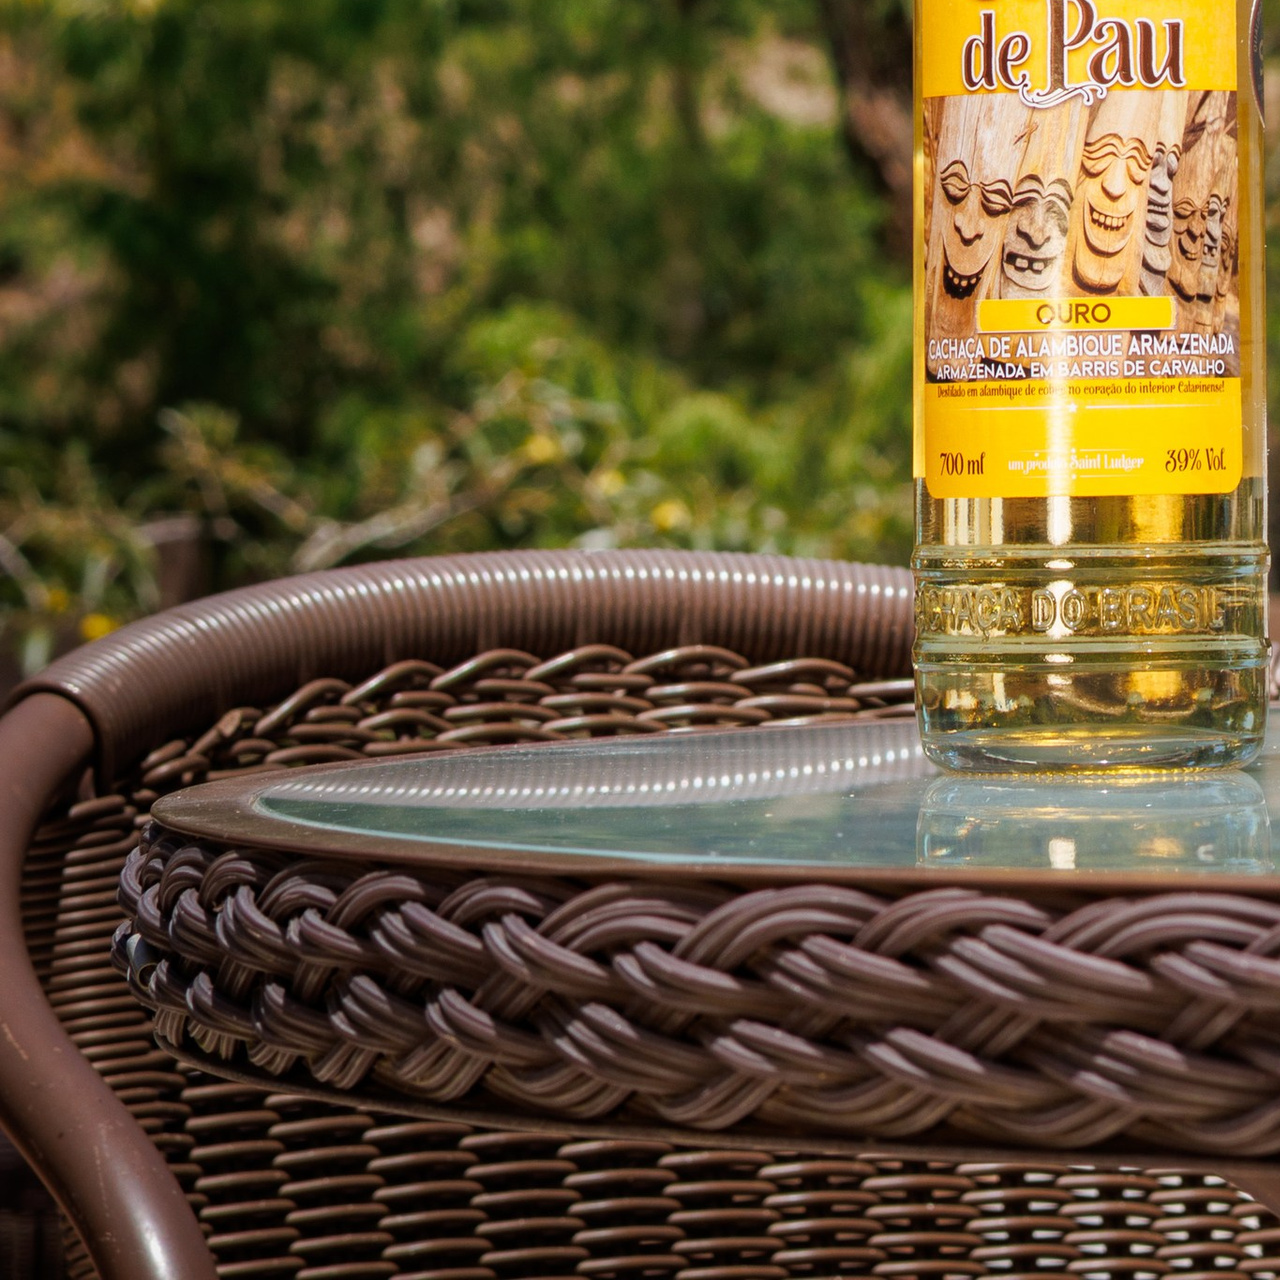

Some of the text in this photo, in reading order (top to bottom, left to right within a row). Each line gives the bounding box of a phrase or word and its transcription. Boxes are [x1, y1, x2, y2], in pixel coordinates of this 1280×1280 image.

[962, 10, 1030, 90] de
[1035, 302, 1112, 325] OURO
[928, 332, 1236, 365] CACHAÇA DE ALAMBIQUE ARMAZENADA
[936, 358, 1226, 381] ARMAZENADA EM BARRIS DE CARVALHO
[966, 387, 978, 397] em
[980, 384, 1022, 401] alambique
[1024, 383, 1036, 397] de
[1038, 383, 1066, 396] cob
[1068, 385, 1081, 396] no
[1083, 383, 1122, 397] coração
[1124, 382, 1137, 395] do
[1139, 381, 1176, 394] interior
[939, 452, 964, 476] 700
[1103, 454, 1144, 472] Ludger
[1165, 447, 1227, 473] 39% Vol.
[1031, 588, 1088, 632] DO
